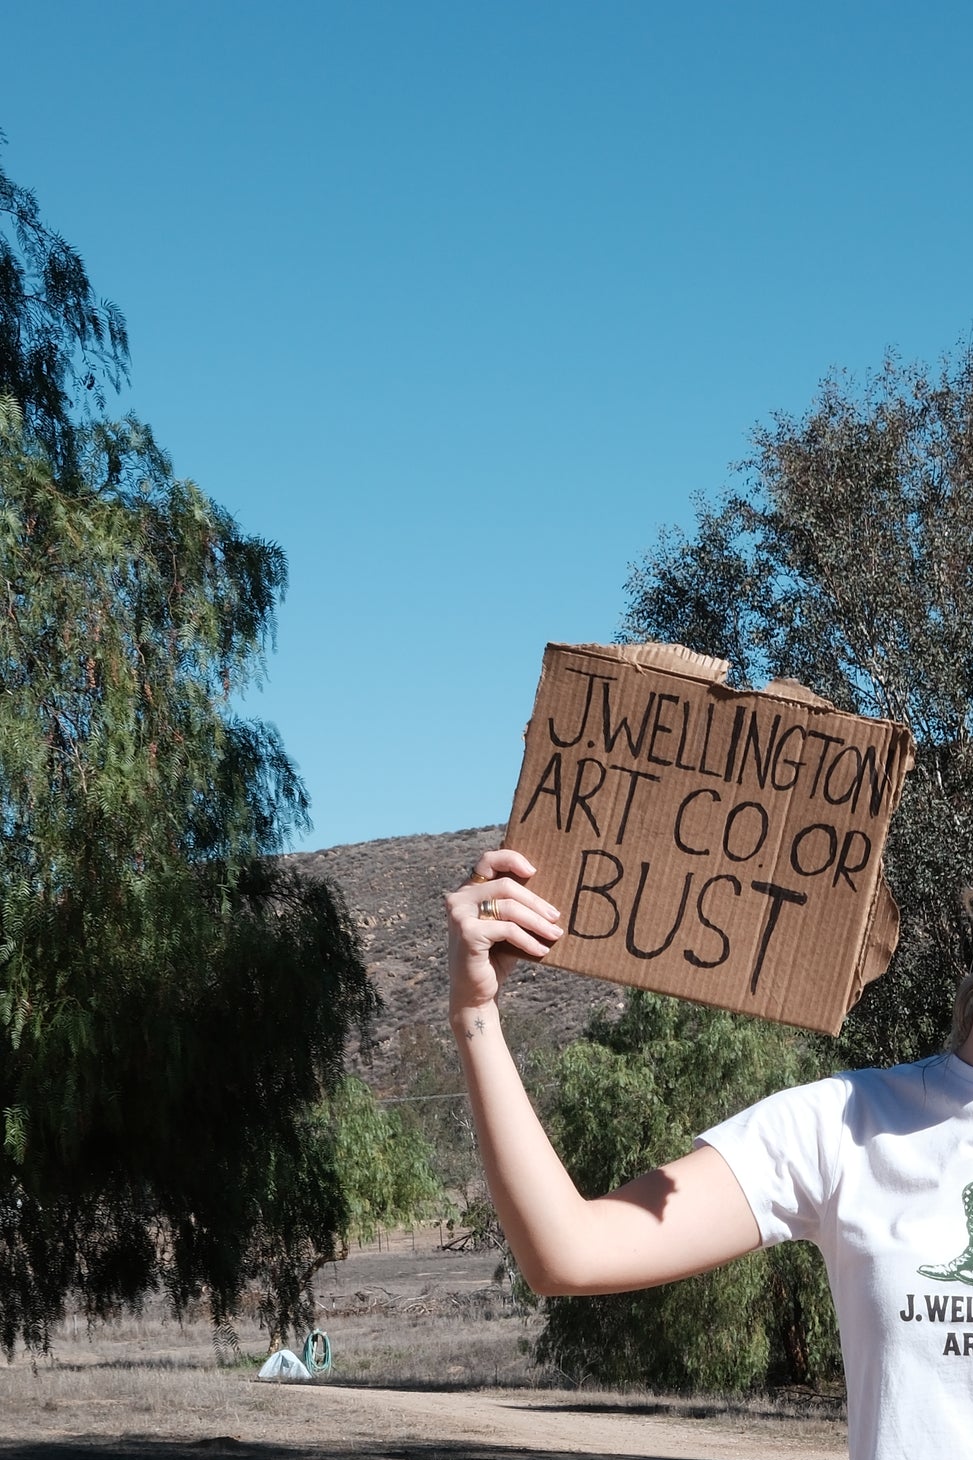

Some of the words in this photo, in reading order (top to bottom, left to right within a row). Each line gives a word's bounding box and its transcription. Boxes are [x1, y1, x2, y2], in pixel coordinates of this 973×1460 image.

[548, 667, 894, 818] J.WELLINGTON
[520, 752, 661, 845] ART
[674, 788, 769, 868] CO.
[790, 823, 872, 892] OR
[568, 849, 808, 995] BUST
